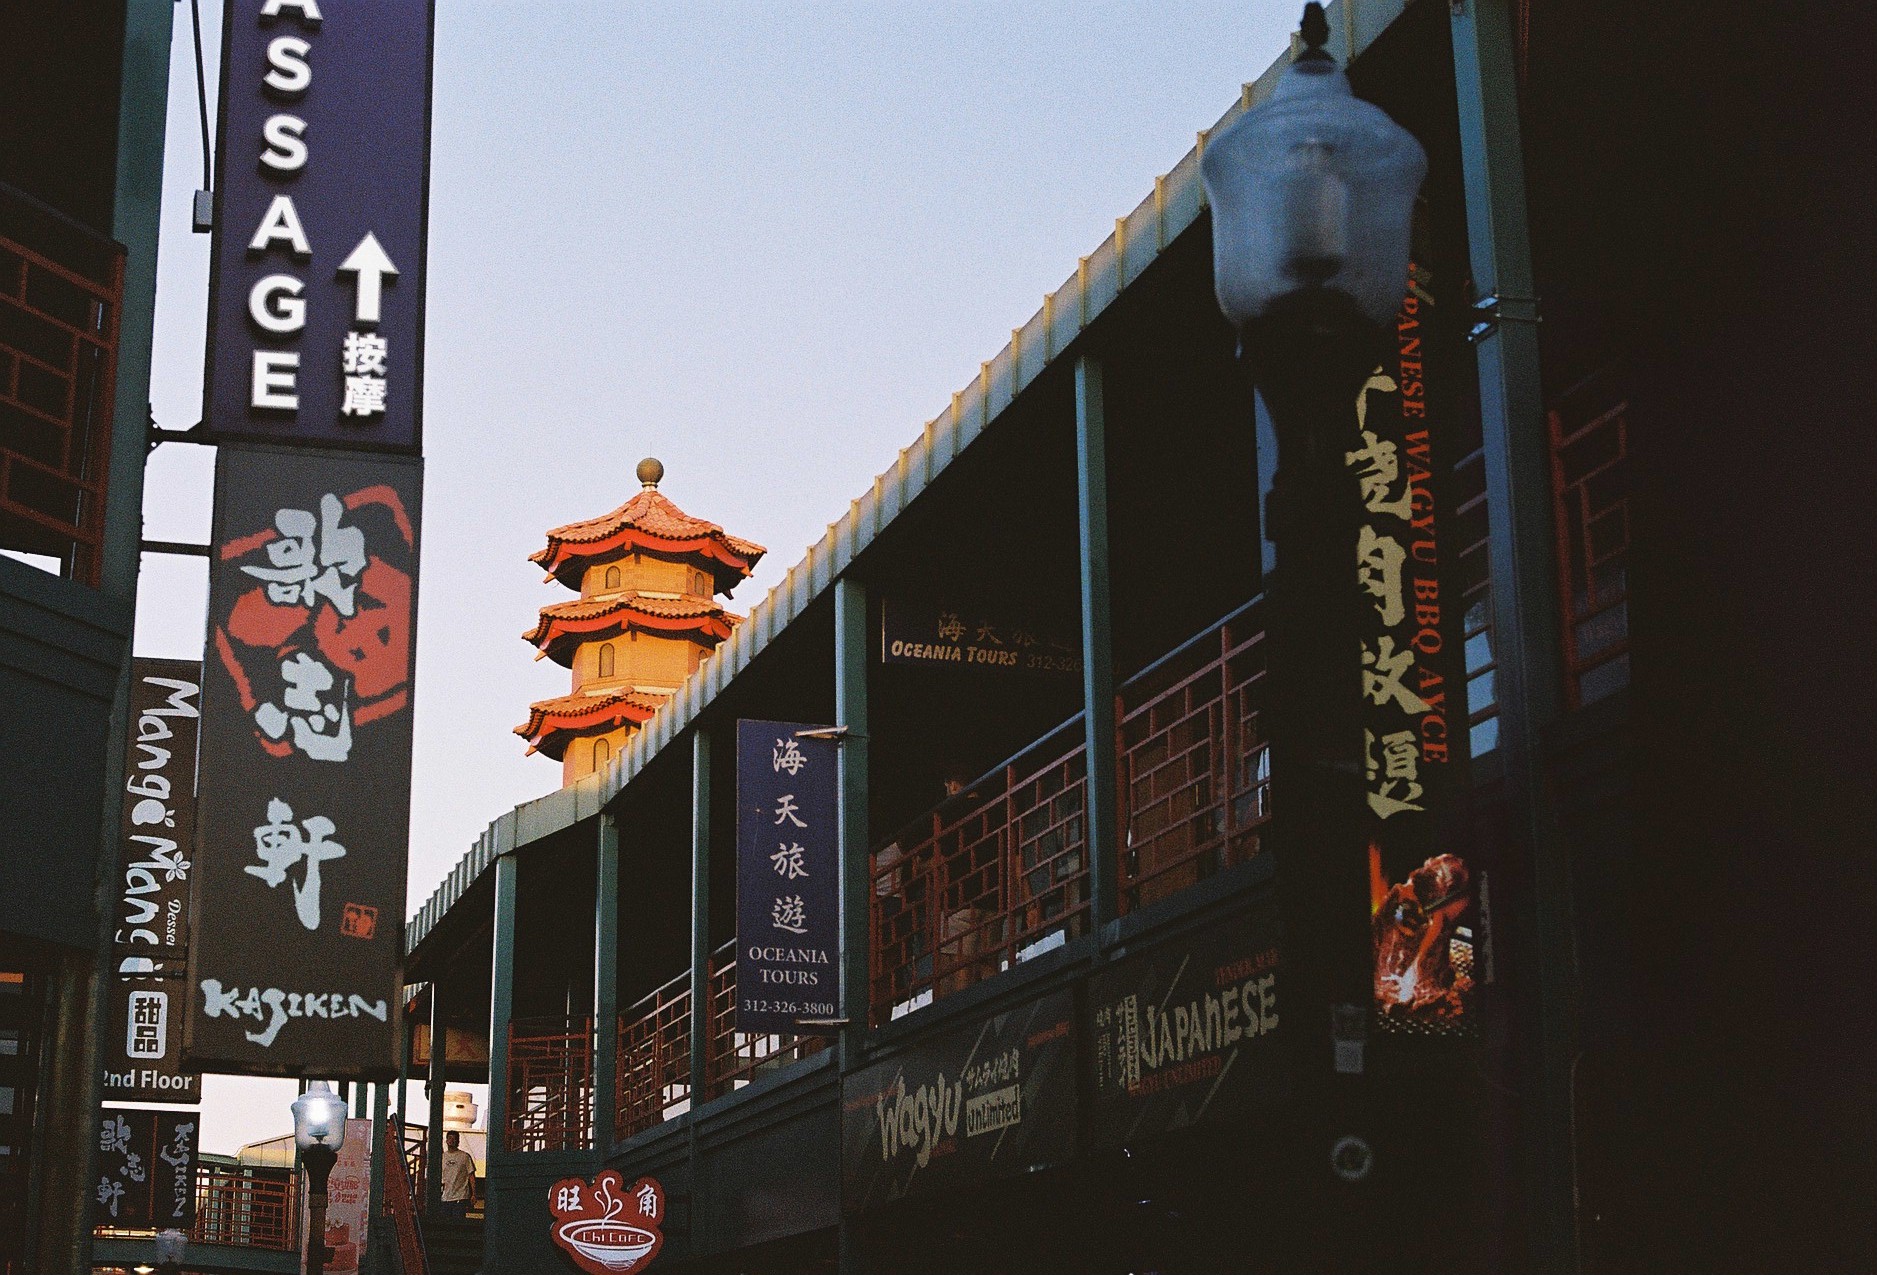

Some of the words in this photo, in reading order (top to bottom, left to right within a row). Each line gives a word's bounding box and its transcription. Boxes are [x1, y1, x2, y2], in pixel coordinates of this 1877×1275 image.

[341, 331, 388, 418] 按摩
[1404, 428, 1438, 565] WAGYU
[891, 640, 962, 662] OCEANIA
[966, 646, 1018, 666] TOURS
[1411, 576, 1443, 655] BBQ
[240, 493, 367, 931] 歌志軒
[1418, 666, 1450, 764] AYCE
[770, 738, 810, 934] 海天旅遊
[748, 945, 829, 965] OCEANIA
[760, 968, 818, 985] TOURS
[132, 996, 161, 1054] 甜品
[201, 979, 387, 1047] KAJIKEN
[743, 999, 834, 1015] 312-326-3800
[1141, 973, 1280, 1069] JAPANESE
[141, 1070, 194, 1091] Floor
[876, 1072, 962, 1169] Wagyu
